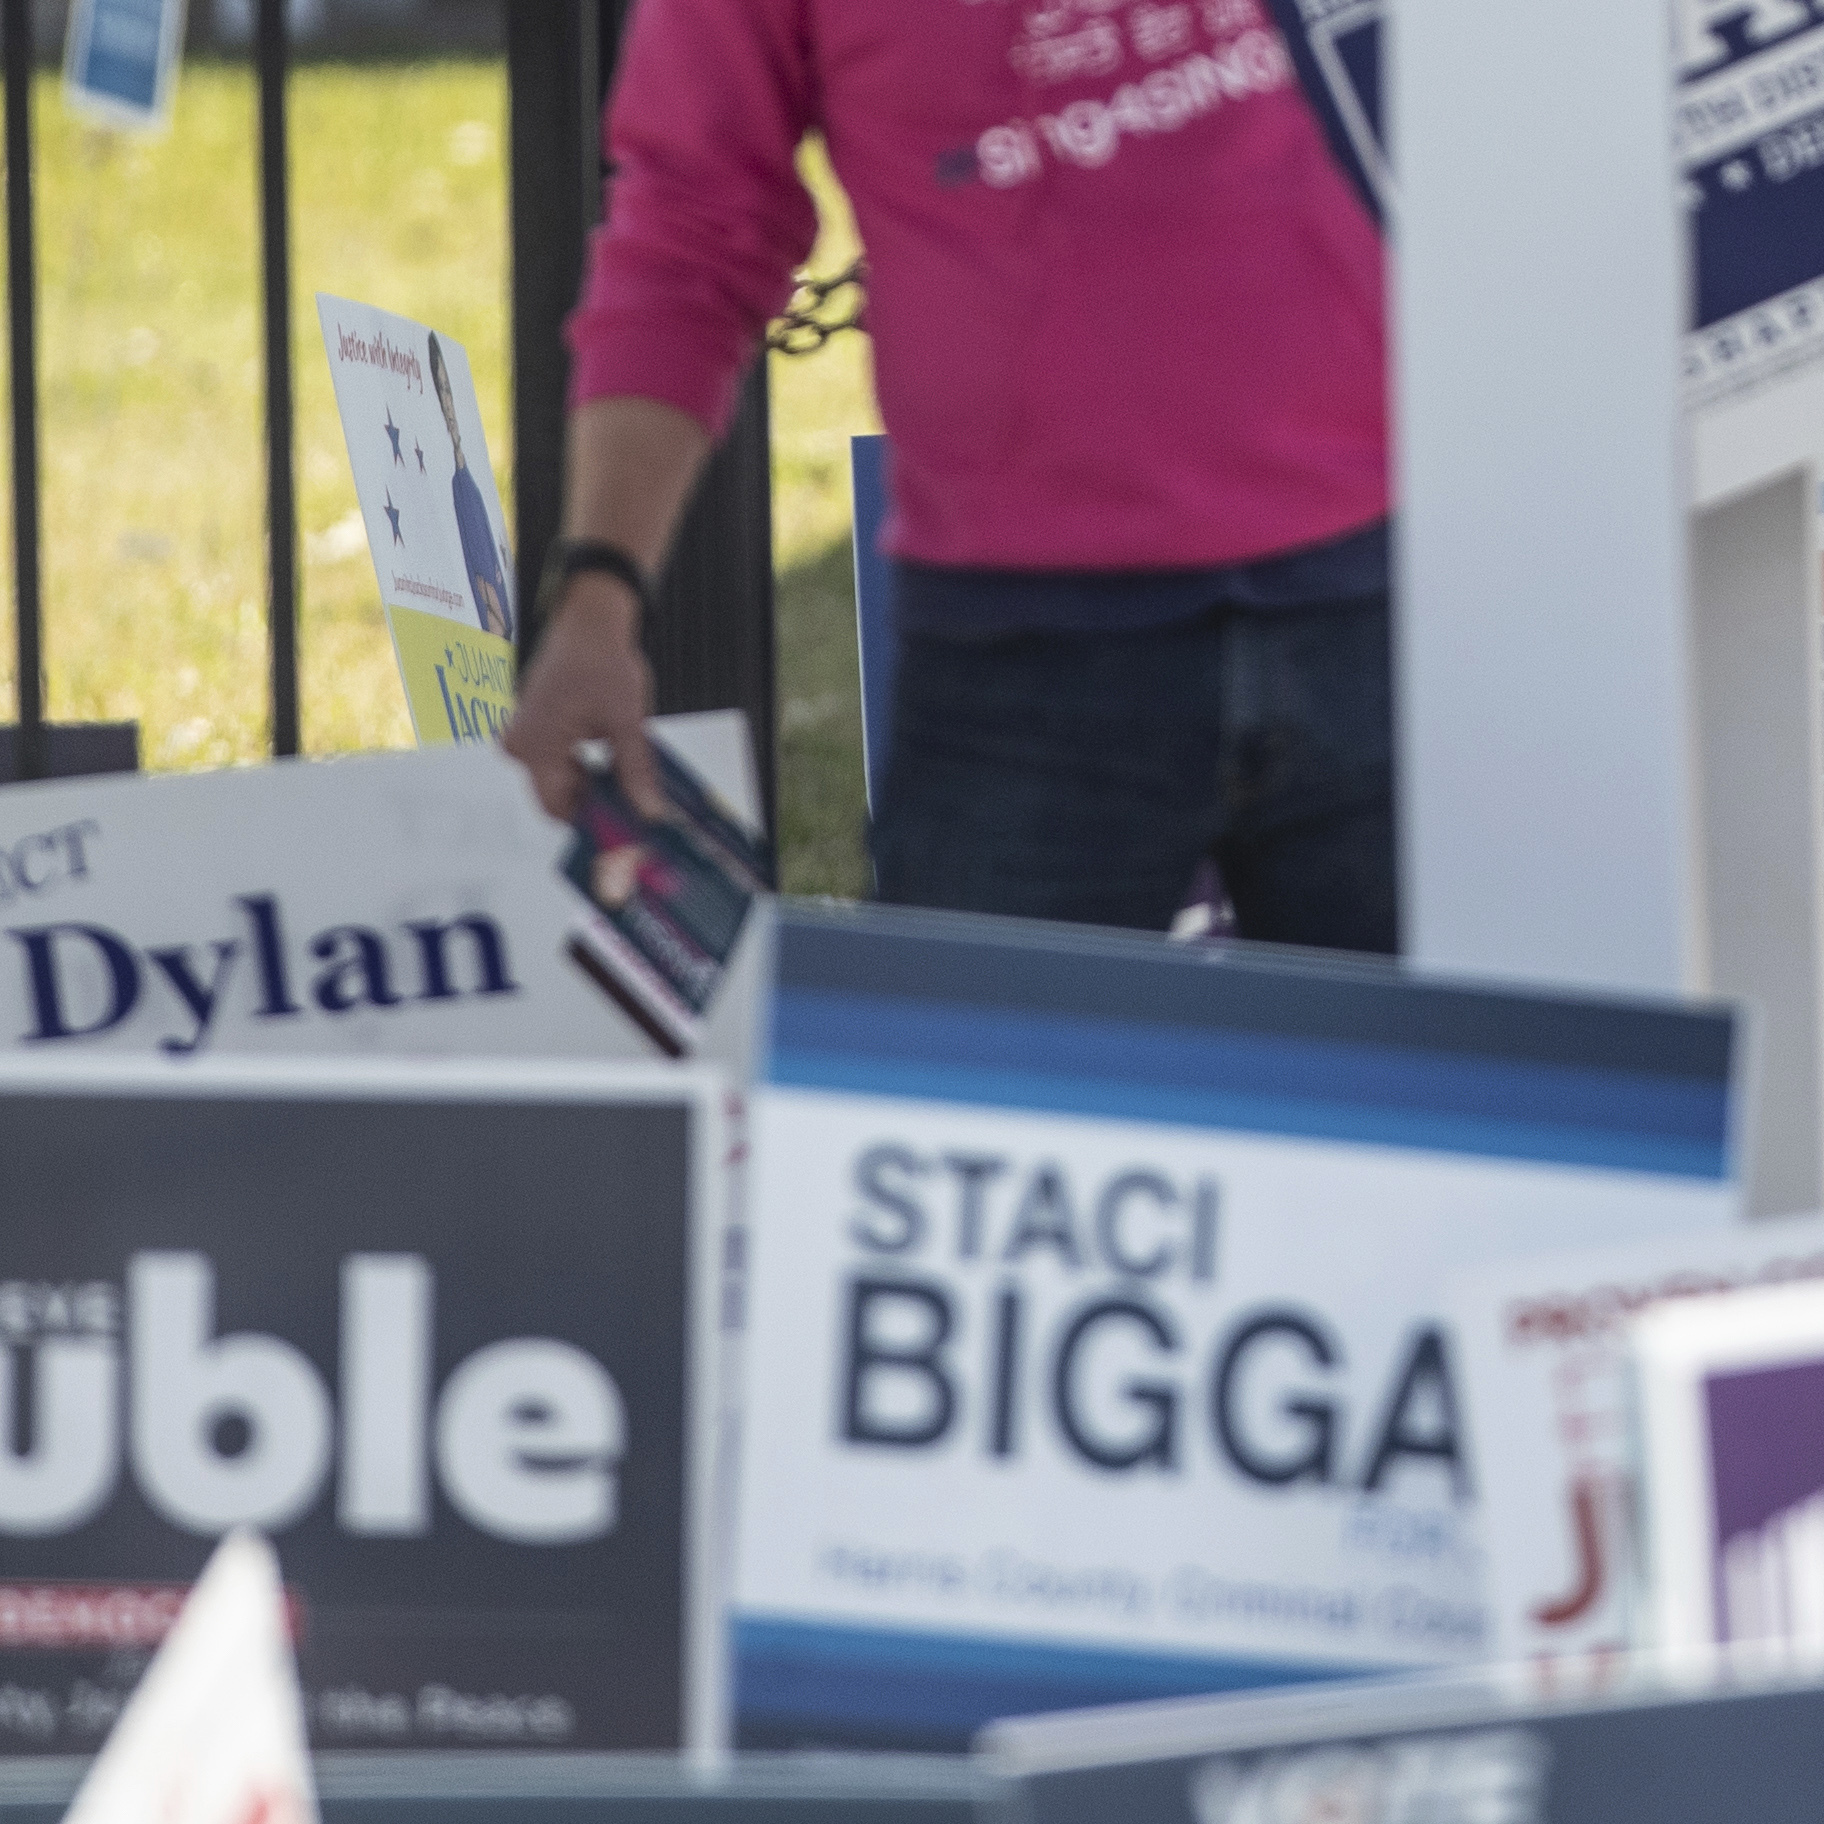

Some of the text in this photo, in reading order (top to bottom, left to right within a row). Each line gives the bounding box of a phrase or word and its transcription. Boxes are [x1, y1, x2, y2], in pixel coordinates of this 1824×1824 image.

[337, 321, 368, 364] Justice
[368, 330, 388, 369] with
[5, 892, 520, 1057] Dylan
[848, 1140, 1226, 1289] STACI
[0, 1248, 629, 1546] uble
[835, 1266, 1476, 1511] BIGGA
